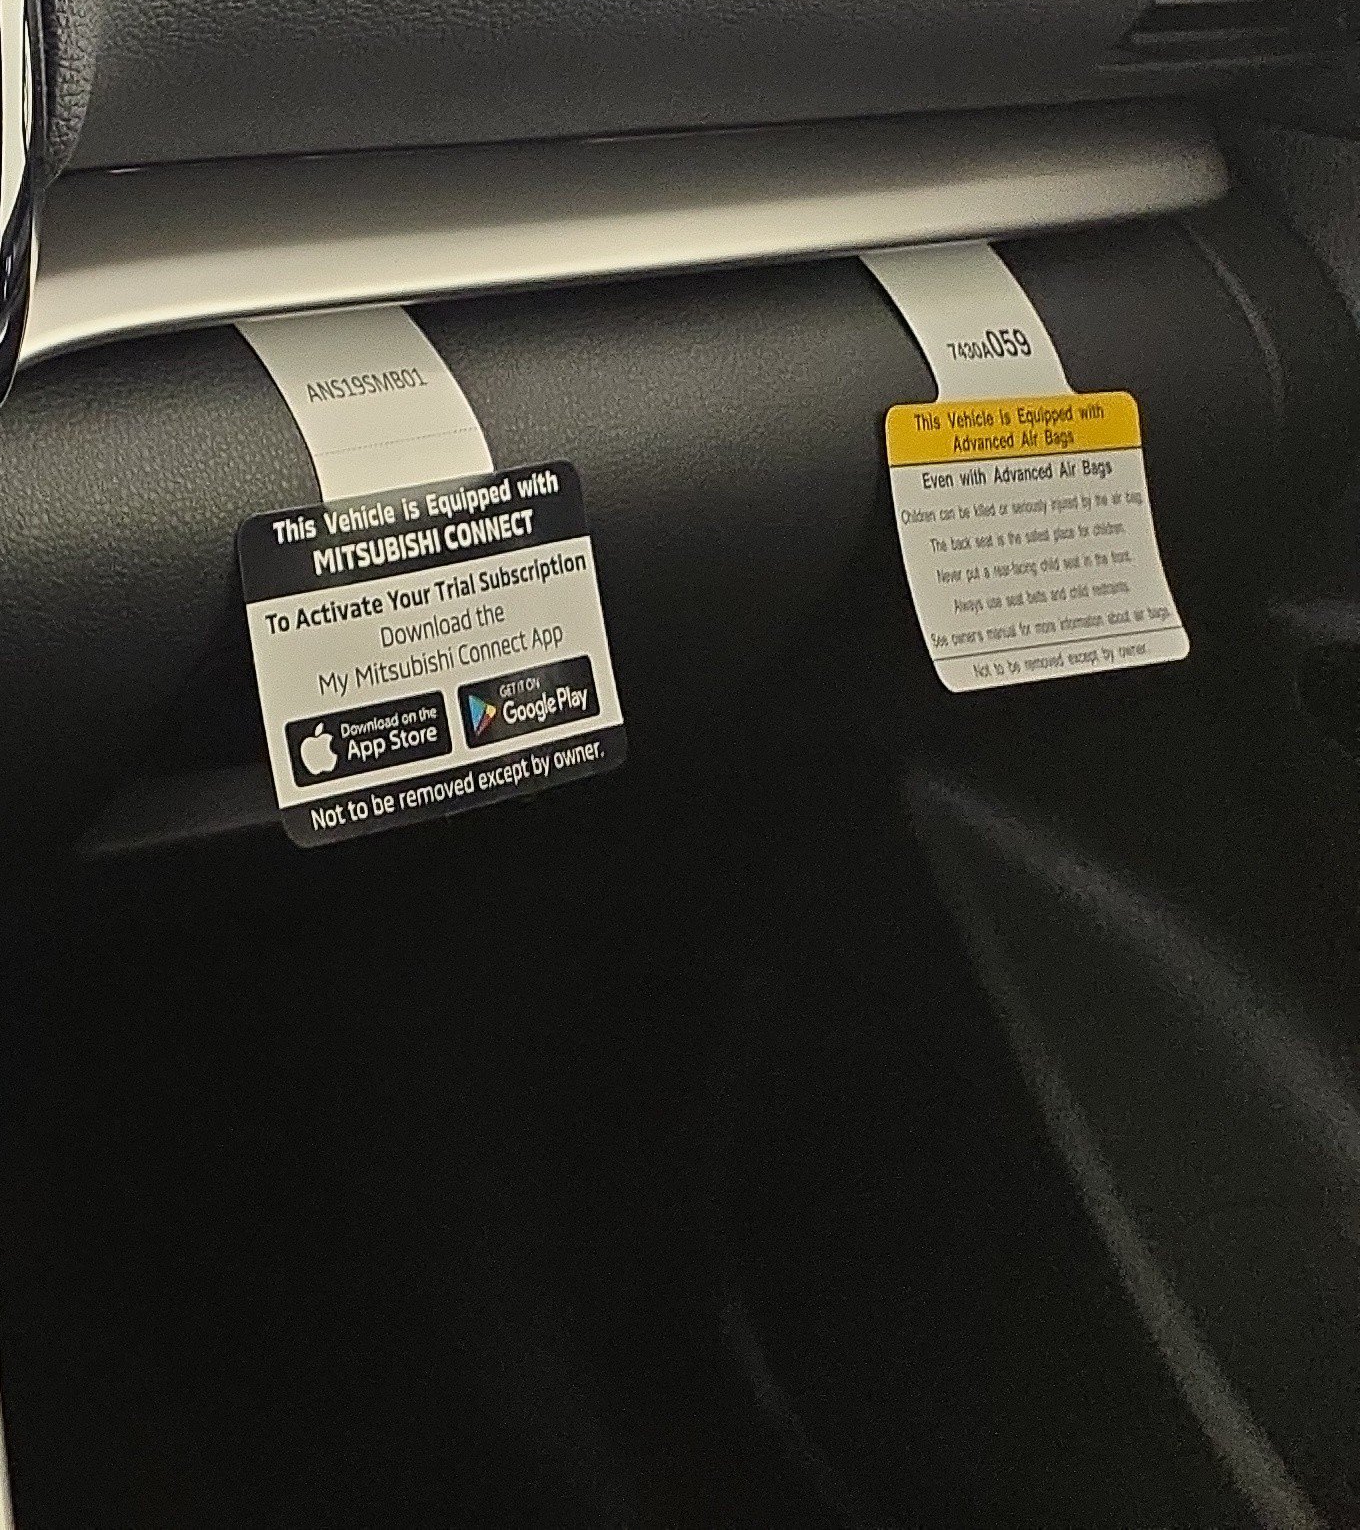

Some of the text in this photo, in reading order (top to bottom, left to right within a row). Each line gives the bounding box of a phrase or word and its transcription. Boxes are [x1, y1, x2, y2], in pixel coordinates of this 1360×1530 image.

[947, 327, 1032, 362] 7430A059
[914, 412, 941, 432] This
[947, 409, 995, 429] Vehicle
[1017, 405, 1074, 427] Equipped
[1079, 403, 1105, 420] with
[952, 427, 1076, 454] Advanced Air Bags
[921, 458, 1114, 490] Even with Advanced Air Bags
[272, 470, 559, 545] This Vehicle is Equipped with
[313, 508, 533, 576] MITSUBISHI CONNECT
[264, 553, 587, 635] To Activate Your Trial Subscription
[380, 604, 505, 648] Download the
[318, 625, 564, 697] My Mitsubishi Connect App
[499, 682, 517, 698] GET
[502, 686, 588, 724] Google Play
[340, 706, 437, 739] Download on the
[347, 726, 438, 762] App Store
[310, 741, 605, 831] Not to be removed except by owner.
